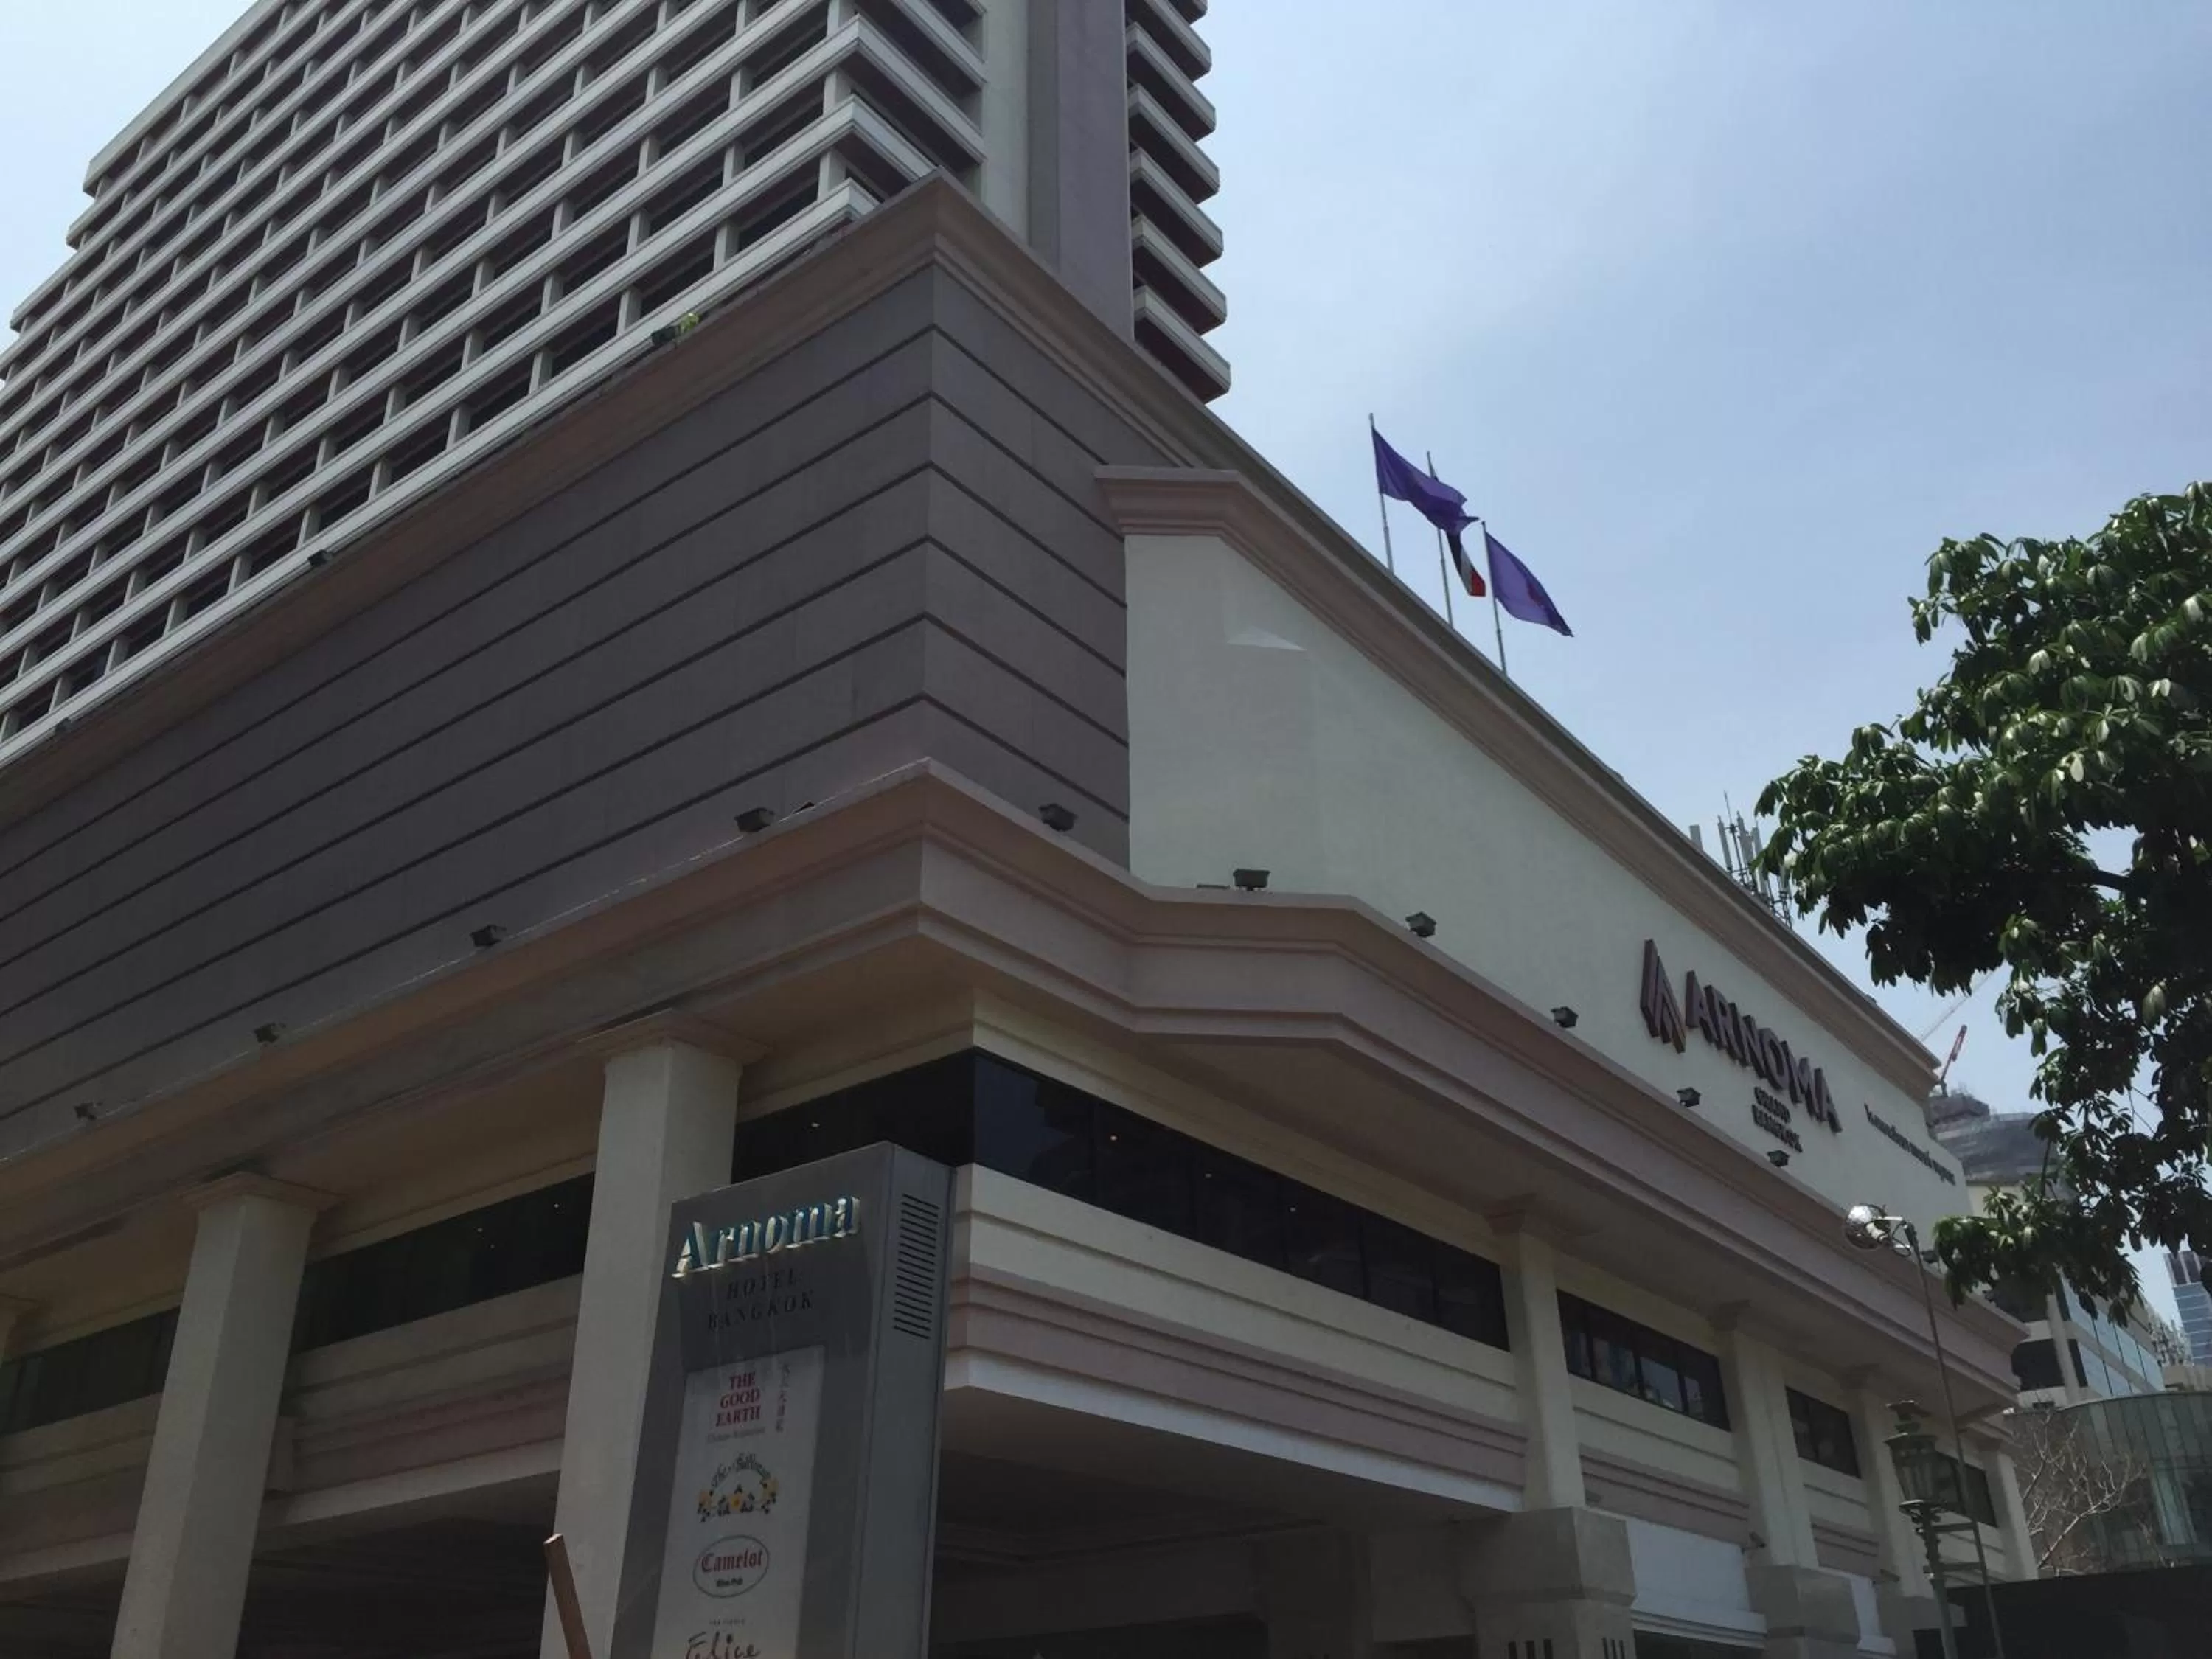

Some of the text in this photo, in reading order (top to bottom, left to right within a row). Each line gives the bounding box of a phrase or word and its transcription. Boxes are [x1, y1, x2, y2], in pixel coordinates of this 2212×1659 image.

[1686, 970, 1843, 1134] ARNOMA
[672, 1196, 861, 1279] Arnoma
[726, 1267, 799, 1300] HOTEL
[708, 1289, 814, 1330] BANGKOK
[728, 1371, 756, 1390] THE
[720, 1388, 761, 1409] GOOD
[715, 1405, 762, 1427] EARTH
[700, 1548, 764, 1573] Camelot
